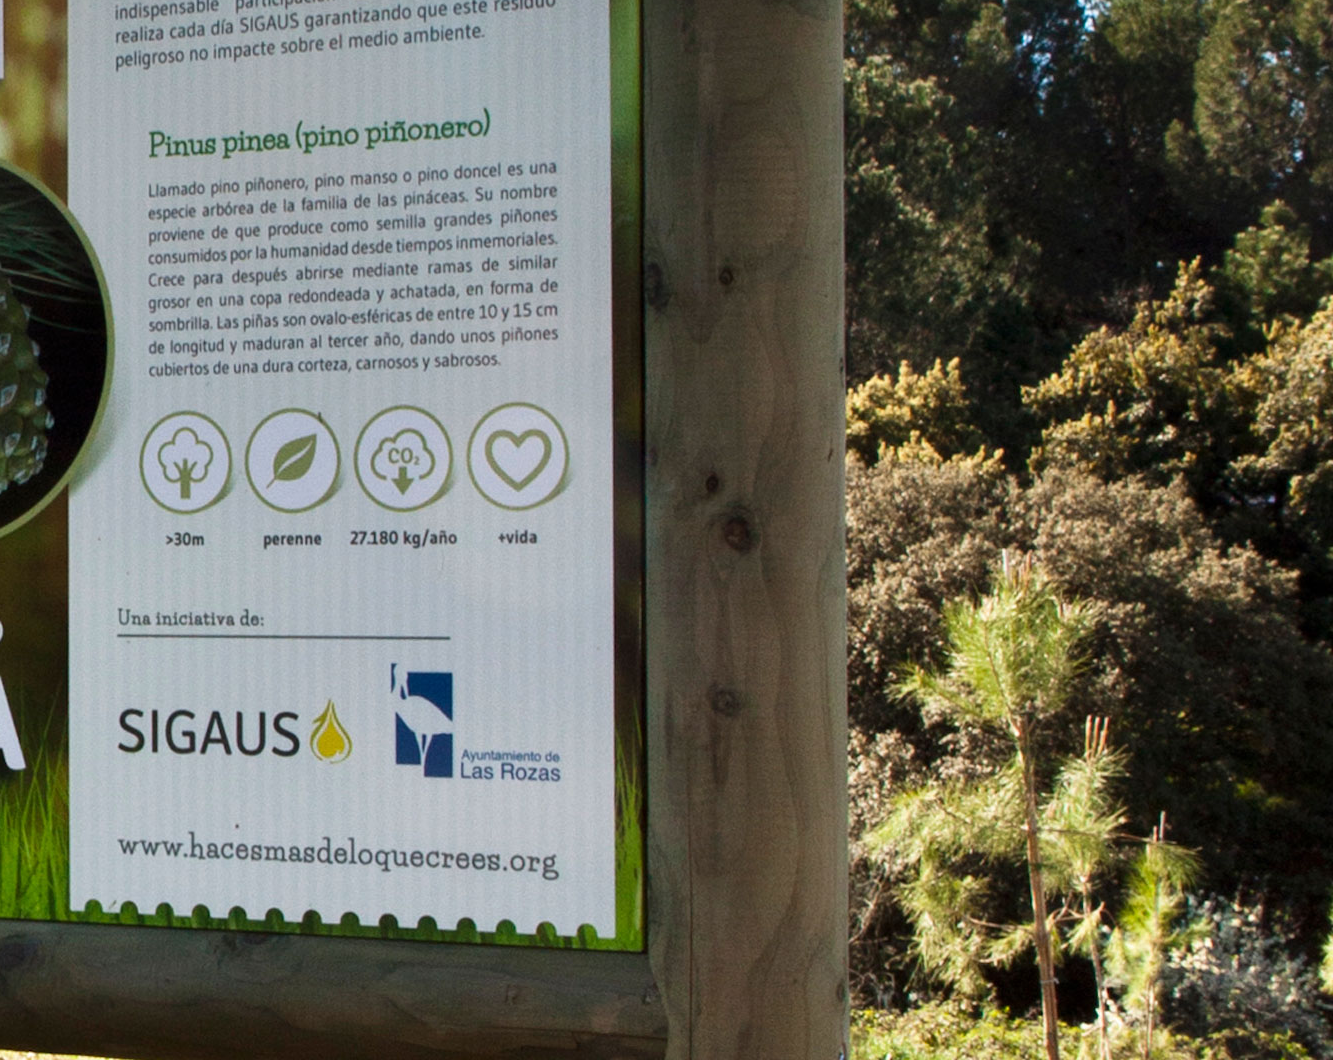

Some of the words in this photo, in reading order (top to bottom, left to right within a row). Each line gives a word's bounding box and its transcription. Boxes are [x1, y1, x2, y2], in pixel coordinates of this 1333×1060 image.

[115, 50, 185, 72] peligroso
[189, 48, 209, 62] no
[213, 41, 276, 62] impacte
[281, 37, 325, 54] sobre
[329, 34, 343, 51] el
[348, 30, 399, 48] medio
[403, 24, 485, 44] ambiente.
[148, 130, 217, 158] Pinus
[221, 130, 291, 160] pinea
[295, 120, 360, 155] (pino
[364, 107, 491, 150] piñonero)
[148, 181, 206, 198] Llamado
[210, 181, 240, 198] pino
[245, 177, 309, 196] piñonero,
[314, 175, 345, 192] pino
[350, 172, 398, 185] manso
[402, 171, 412, 183] o
[417, 169, 449, 186] pino
[453, 162, 501, 180] doncel
[507, 164, 524, 177] es
[529, 162, 557, 175] una
[148, 248, 228, 265] consumidos
[230, 249, 253, 265] por
[255, 246, 268, 260] la
[270, 241, 349, 259] humanidad
[351, 239, 393, 255] desde
[395, 238, 453, 255] tiempos
[456, 231, 557, 249] inmemoriales.
[148, 272, 185, 288] Crece
[193, 272, 224, 289] para
[231, 267, 288, 286] después
[295, 266, 344, 281] abrirse
[352, 262, 419, 278] mediante
[427, 261, 473, 274] ramas
[481, 257, 500, 272] de
[508, 255, 558, 271] similar
[166, 531, 205, 547] >30m
[263, 534, 322, 550] perenne
[350, 529, 399, 546] 27.180
[402, 528, 458, 549] kg/año
[498, 529, 538, 545] +vida
[117, 607, 152, 626] Una
[155, 611, 236, 627] iniciativa
[239, 608, 264, 627] de:
[117, 708, 301, 758] SIGAUS
[461, 749, 542, 766] Ayuntamiento
[544, 751, 560, 763] de
[460, 761, 494, 780] Las
[500, 761, 561, 782] Rozas
[117, 831, 560, 881] www.hacesmasdeloquecrees.org
